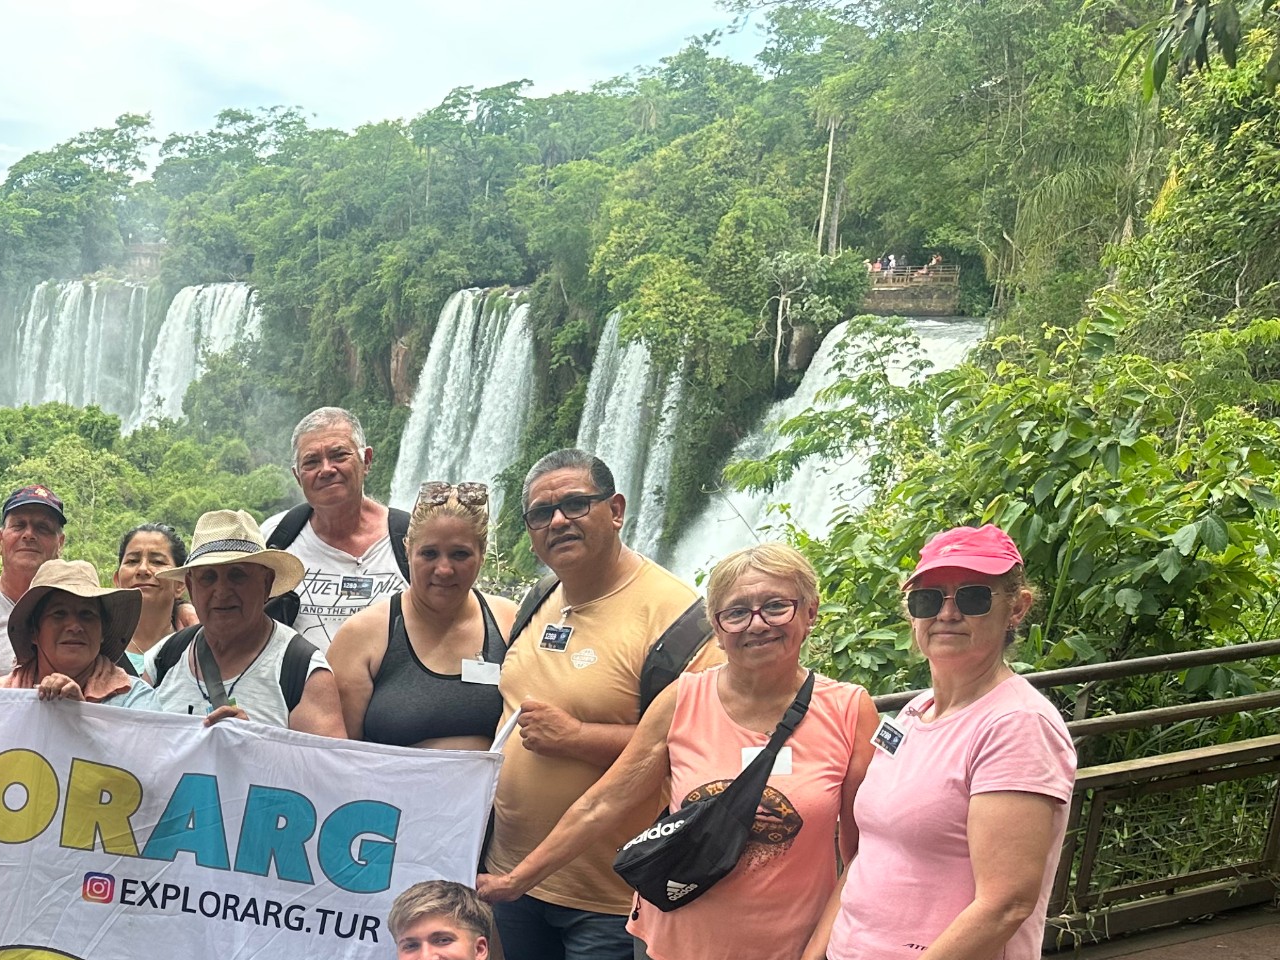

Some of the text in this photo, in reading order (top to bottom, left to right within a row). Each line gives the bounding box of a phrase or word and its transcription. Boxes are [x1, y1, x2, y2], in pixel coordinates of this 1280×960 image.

[302, 606, 363, 616] AND THE NE
[623, 820, 685, 851] adidas
[668, 883, 699, 901] adidas
[120, 879, 381, 943] EXPLORARG.TUR
